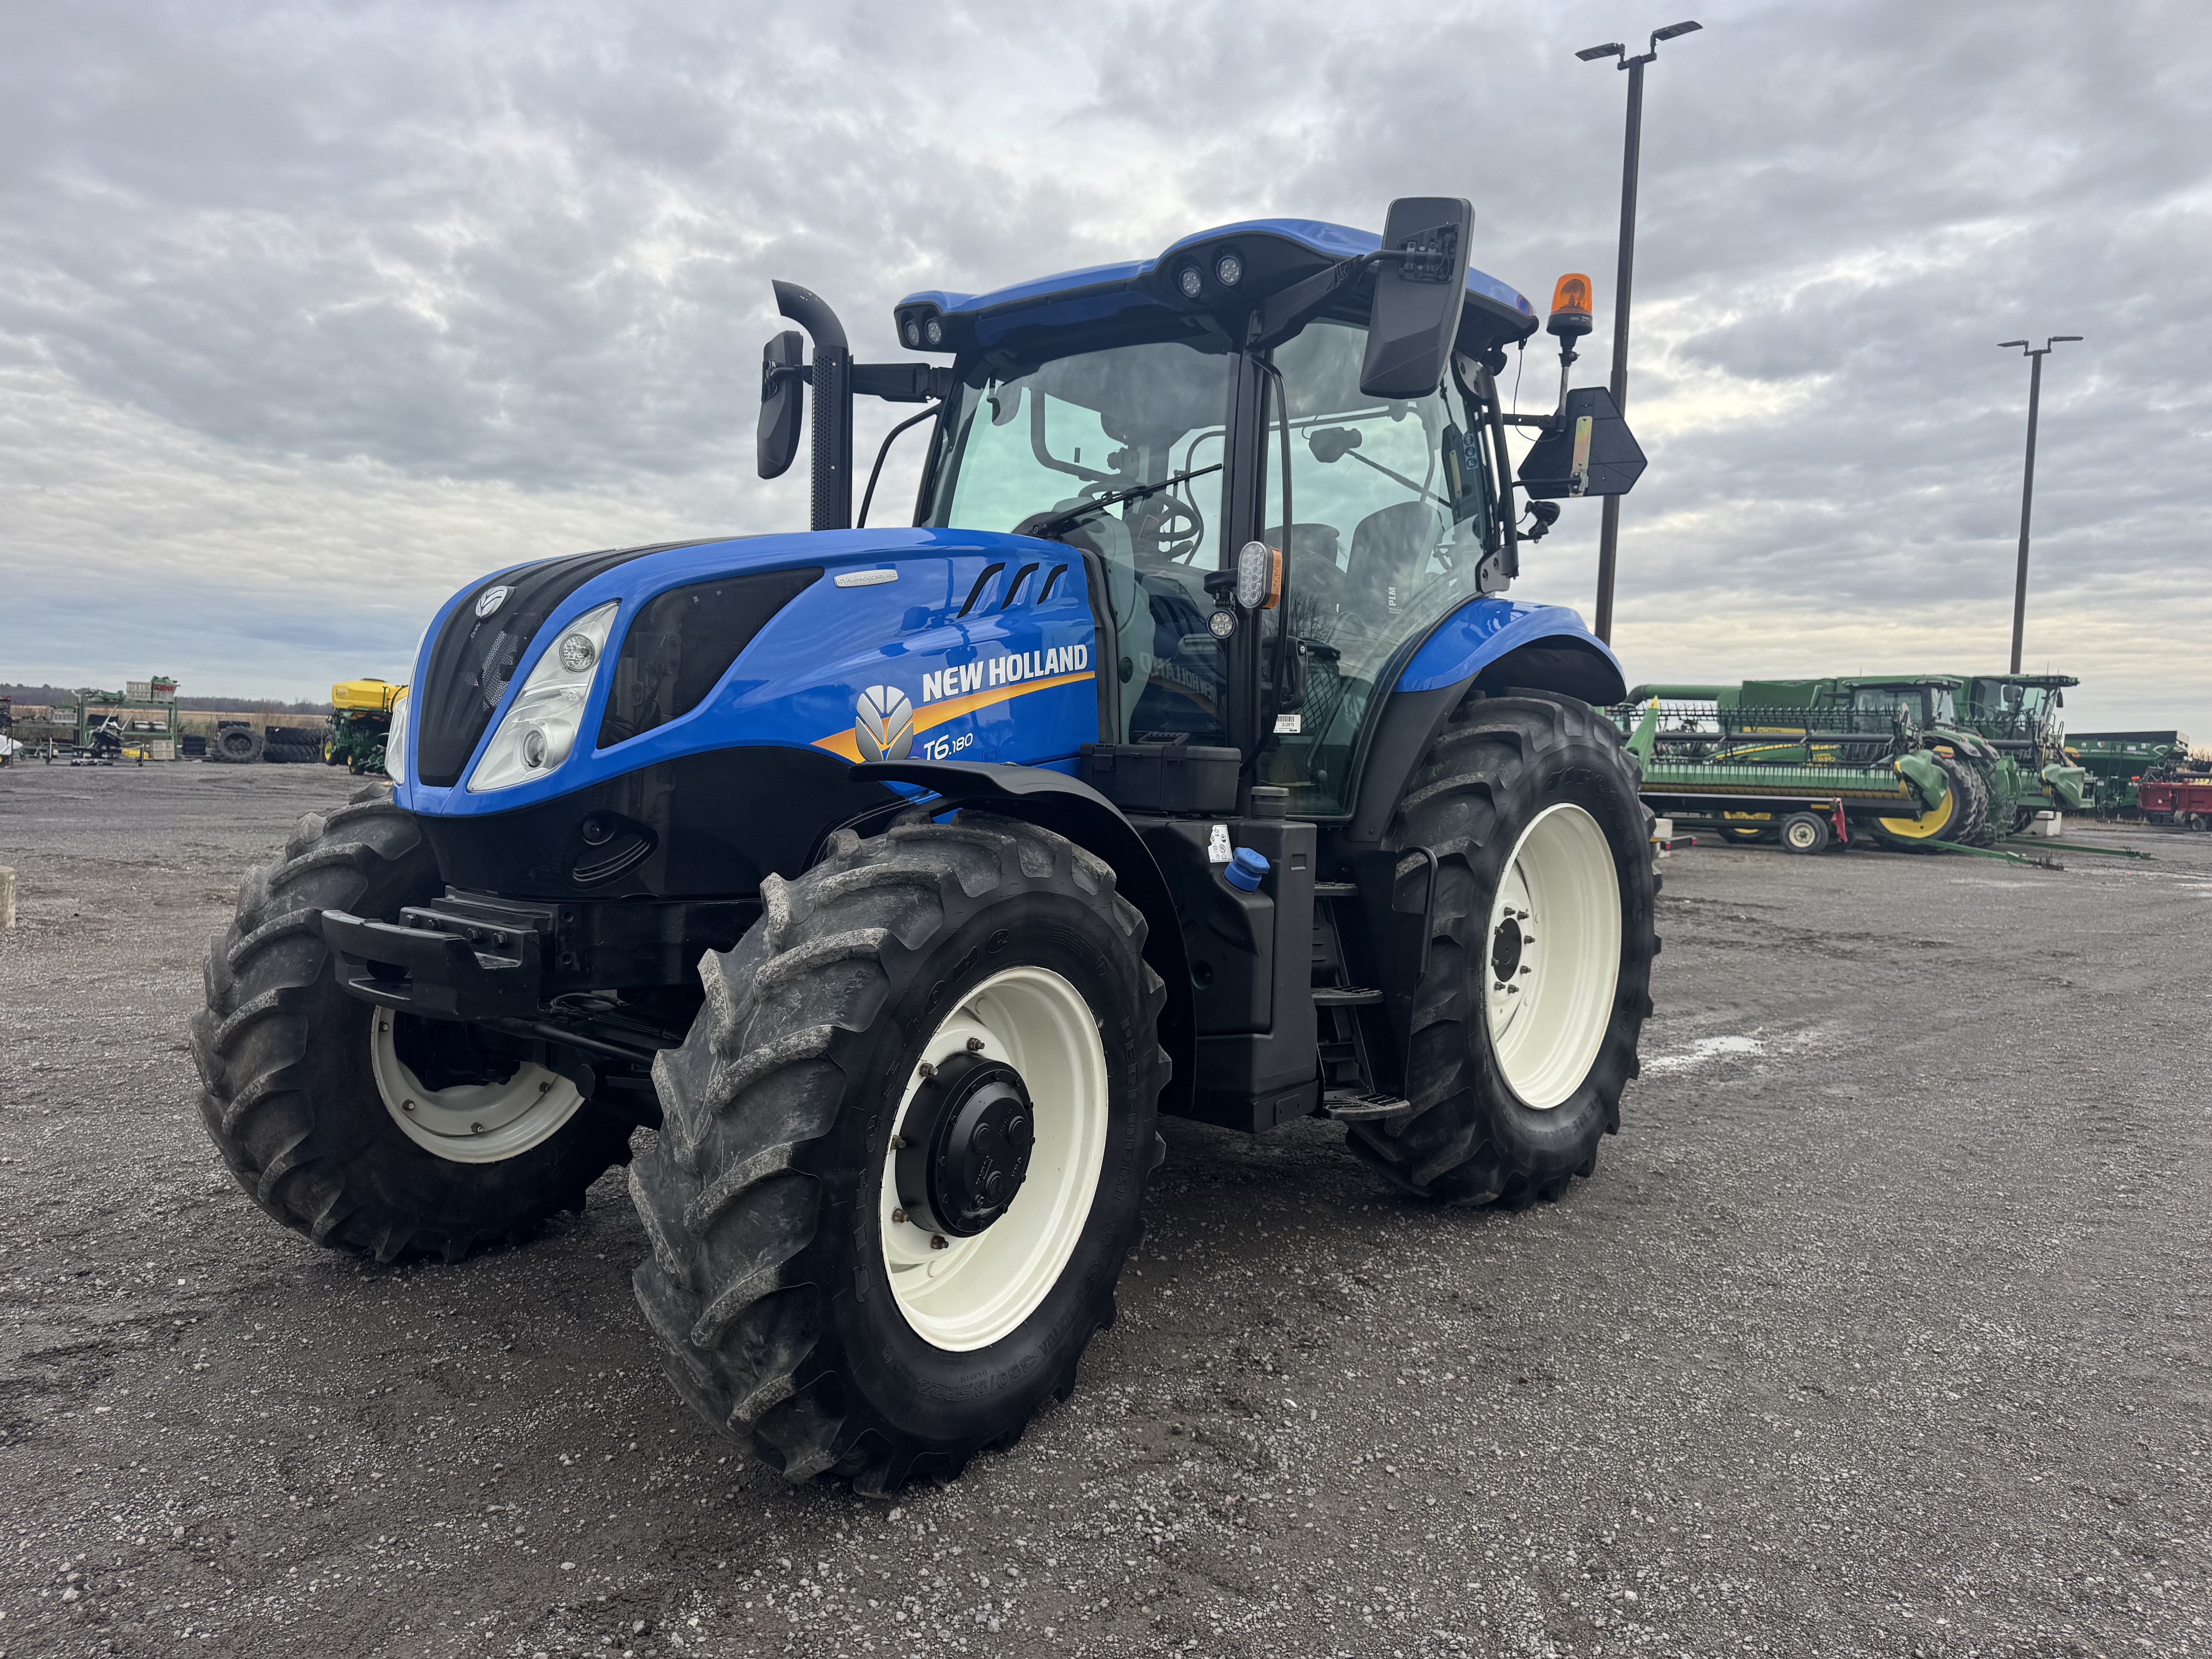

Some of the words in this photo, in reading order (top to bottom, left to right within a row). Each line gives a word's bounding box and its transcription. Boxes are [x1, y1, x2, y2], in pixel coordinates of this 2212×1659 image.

[923, 661, 984, 703] NEW
[989, 644, 1088, 686] HOLLAND
[924, 733, 974, 760] T6.180
